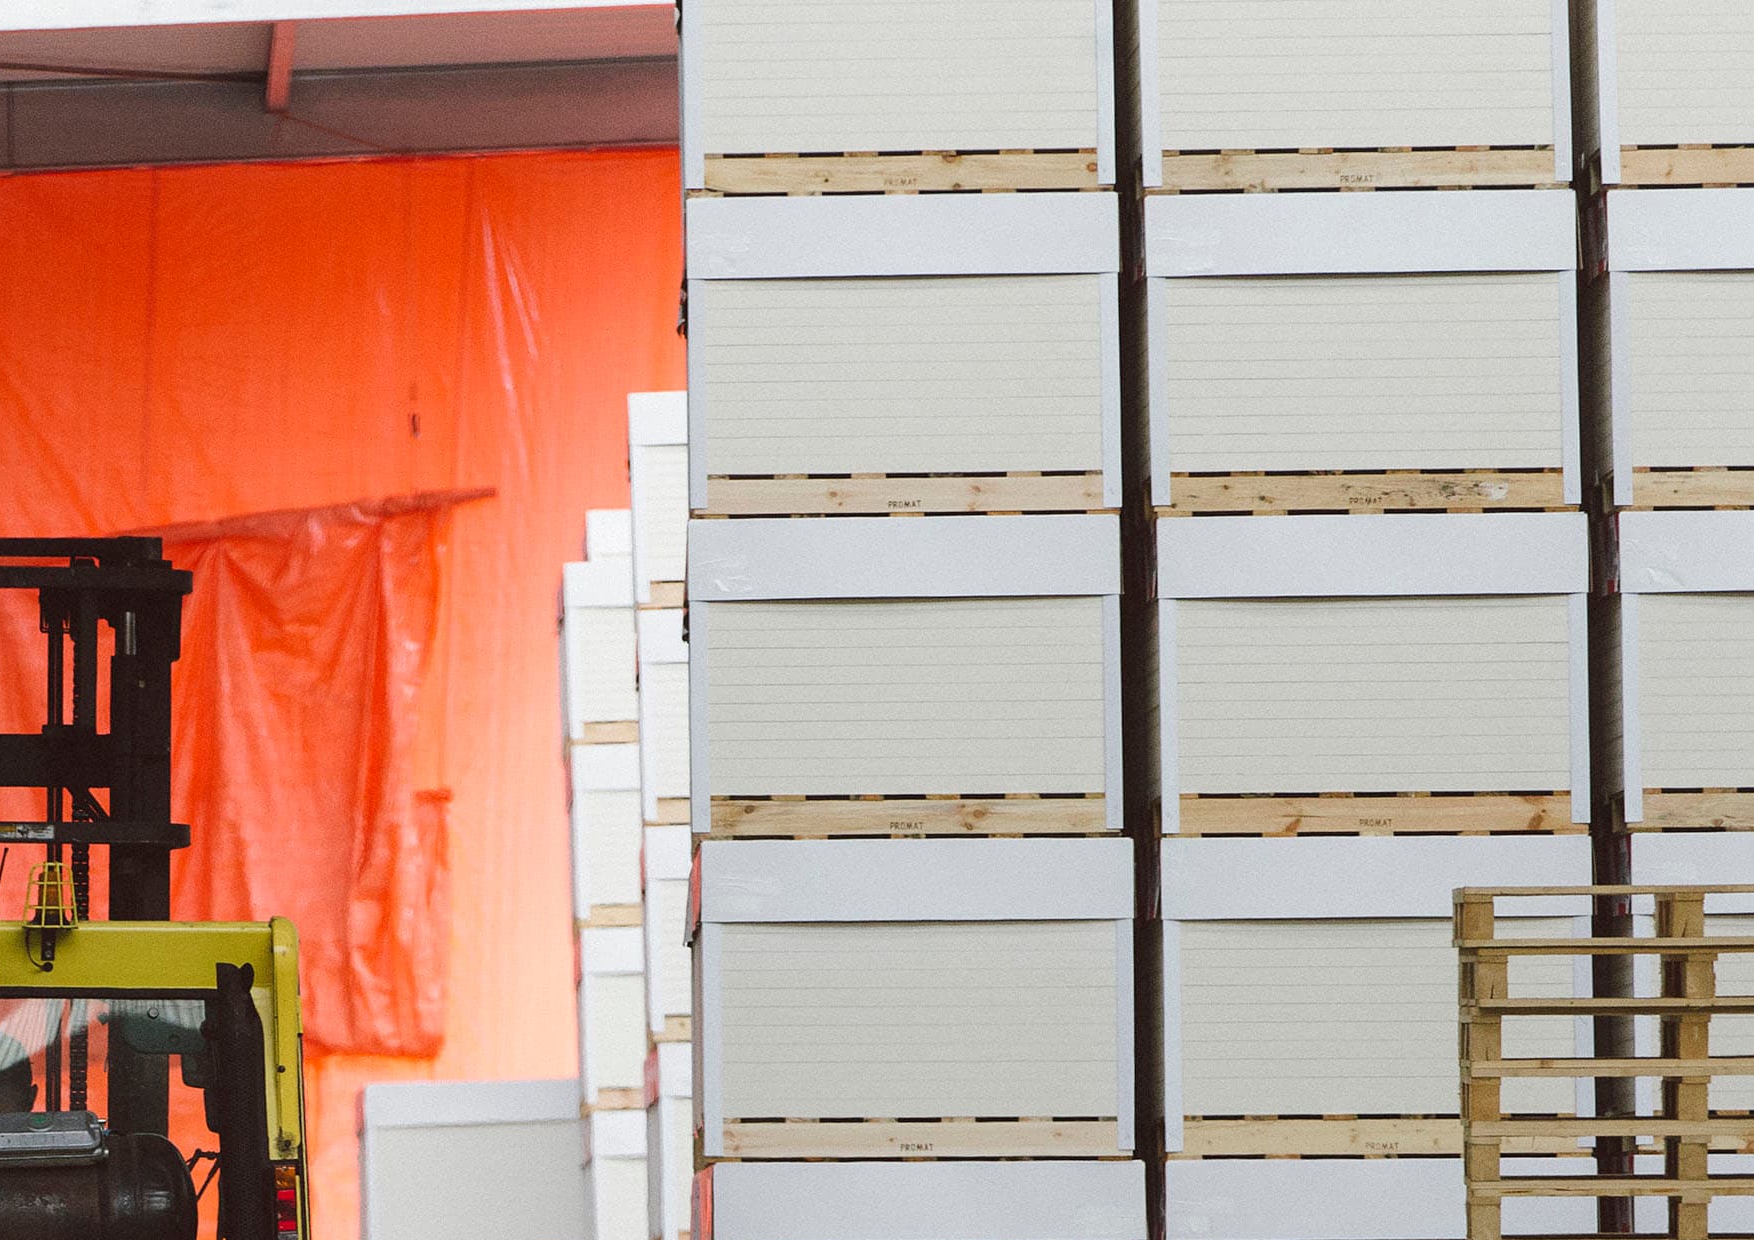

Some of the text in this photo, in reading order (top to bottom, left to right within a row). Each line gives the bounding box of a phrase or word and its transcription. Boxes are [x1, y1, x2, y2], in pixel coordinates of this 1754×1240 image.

[1340, 175, 1374, 183] PROMAT
[888, 500, 921, 509] PROMAT
[890, 822, 924, 831] PROMAT
[1359, 818, 1393, 827] PROMAT
[900, 1143, 934, 1152] PROMAT
